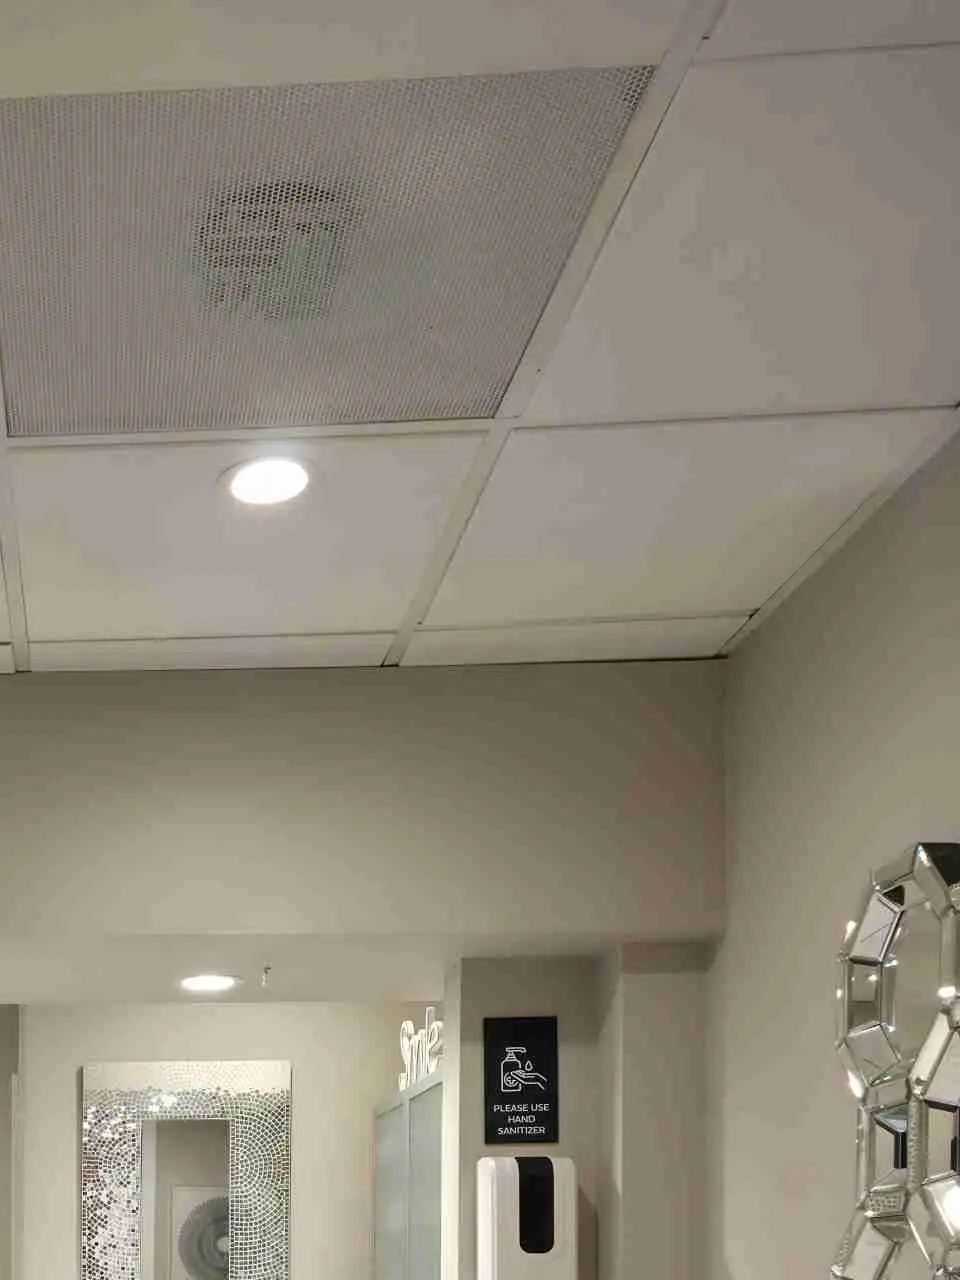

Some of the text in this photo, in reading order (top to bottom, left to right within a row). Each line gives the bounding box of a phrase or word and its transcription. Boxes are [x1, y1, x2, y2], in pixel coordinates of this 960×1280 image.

[493, 1103, 551, 1112] PLEASE USE
[507, 1115, 536, 1124] HAND
[497, 1126, 546, 1135] SANITIZER
